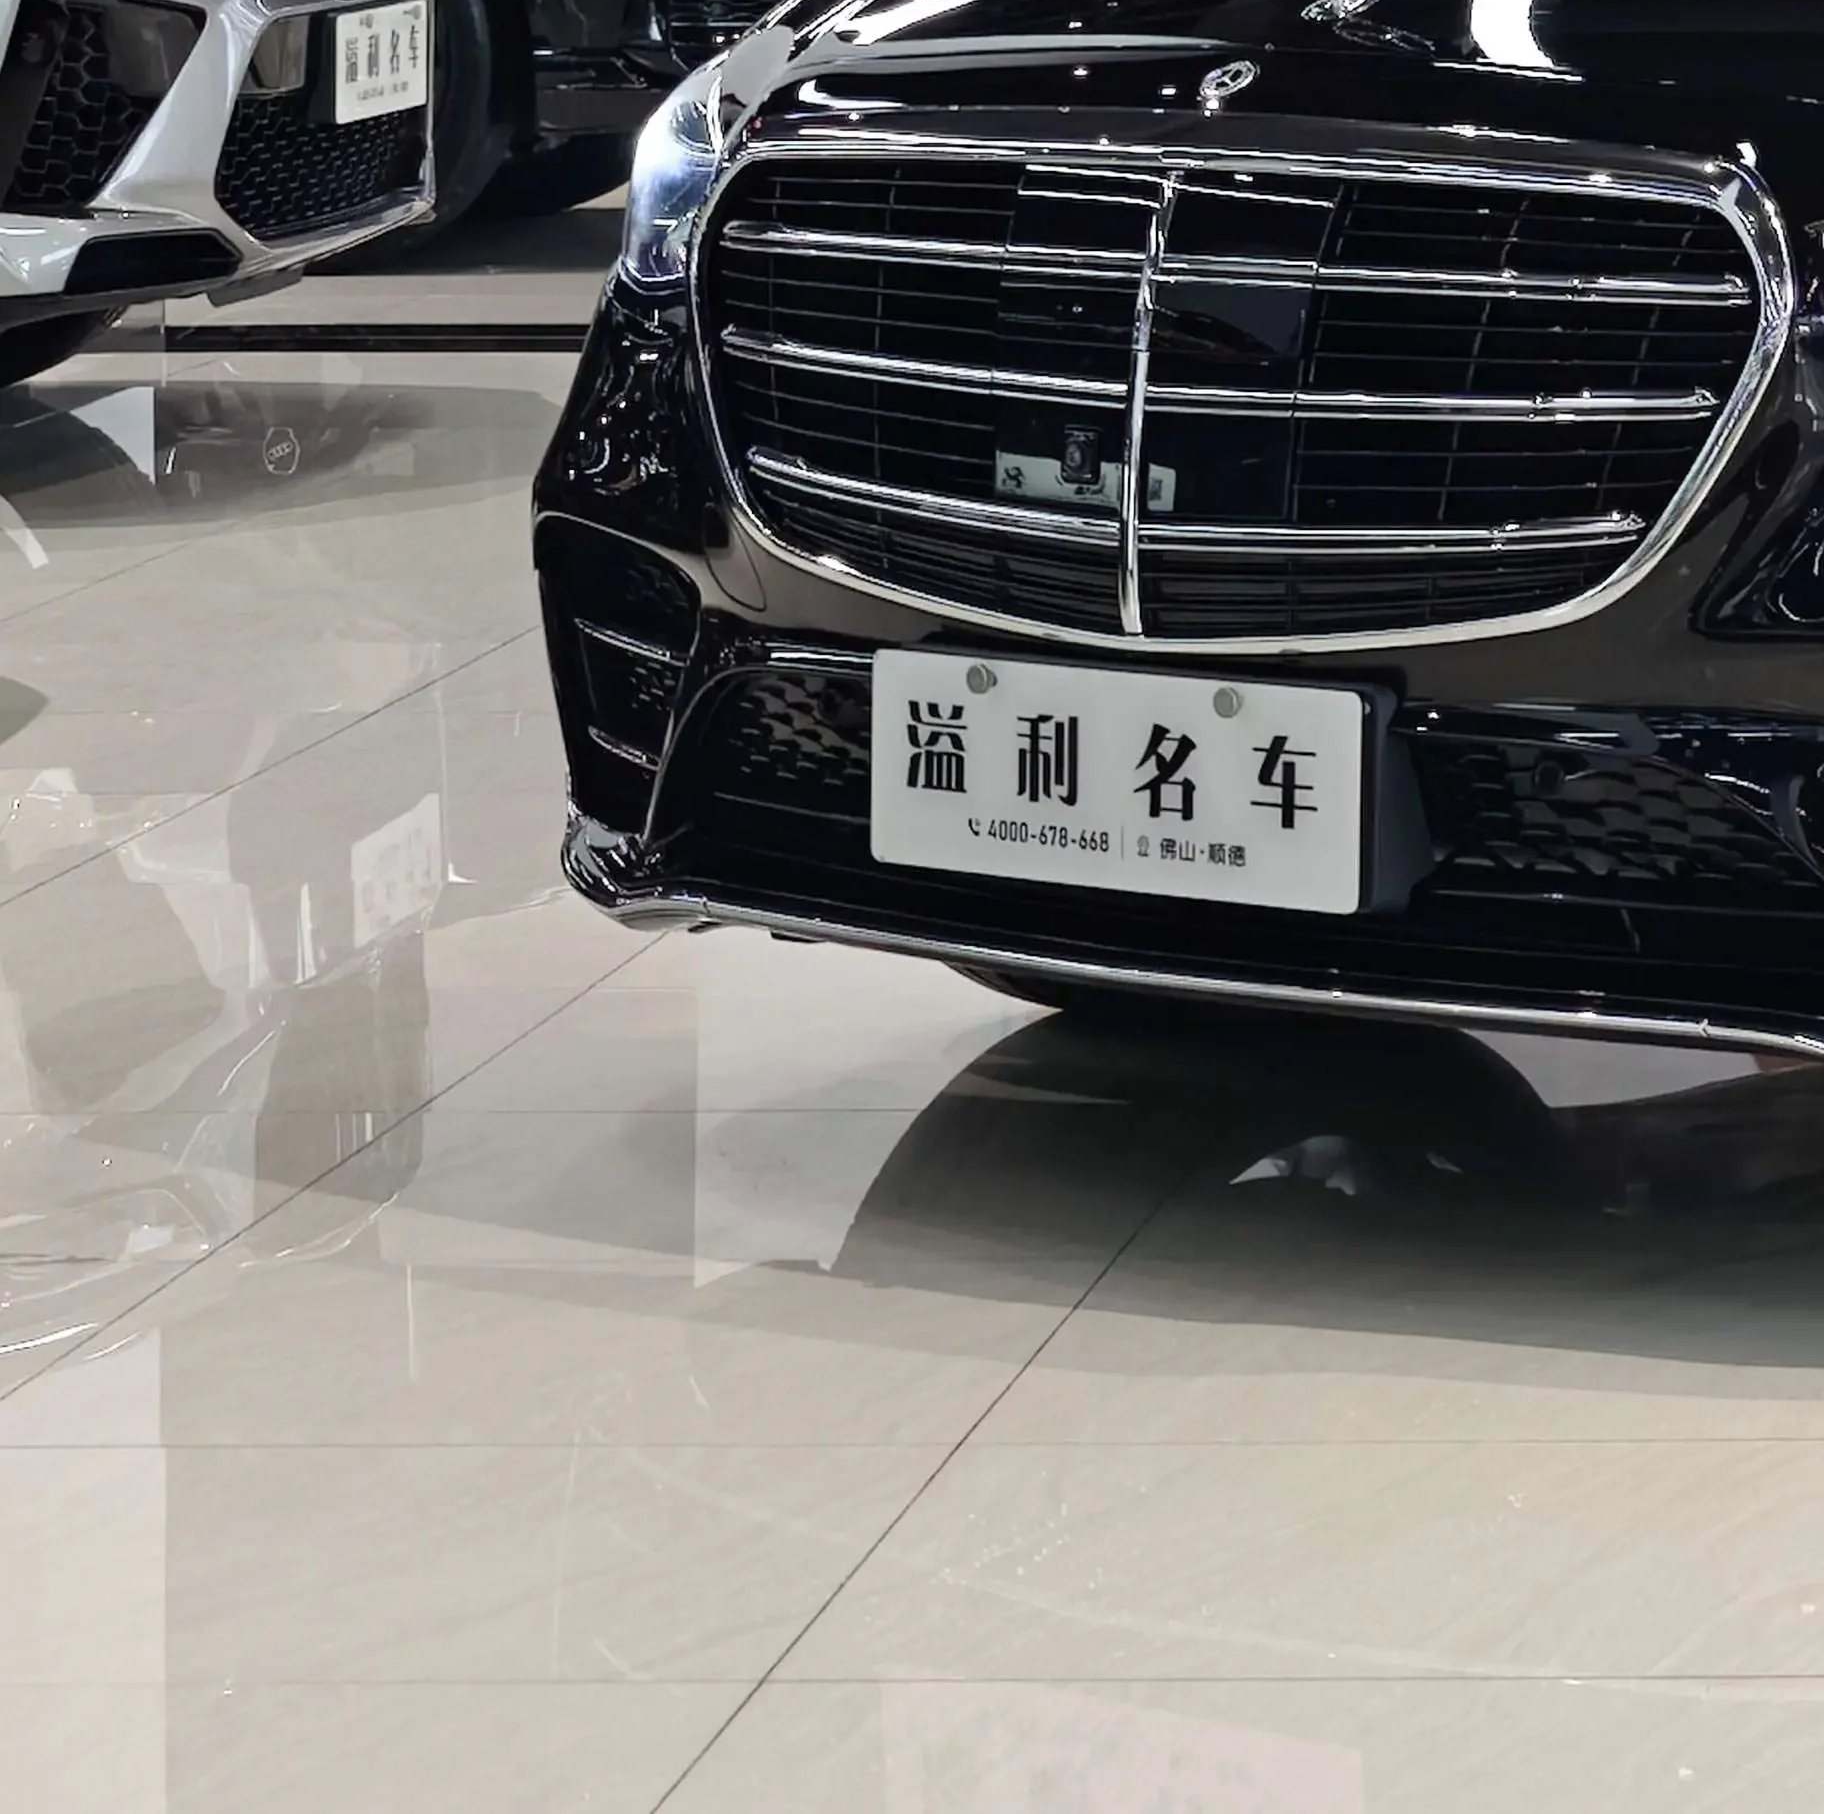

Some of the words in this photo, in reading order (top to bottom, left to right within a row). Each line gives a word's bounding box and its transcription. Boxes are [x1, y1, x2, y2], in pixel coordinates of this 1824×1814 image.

[906, 699, 1319, 831] 溢利名车
[987, 819, 1110, 853] 4000-678-668
[1159, 837, 1247, 867] 佛山·顺德
